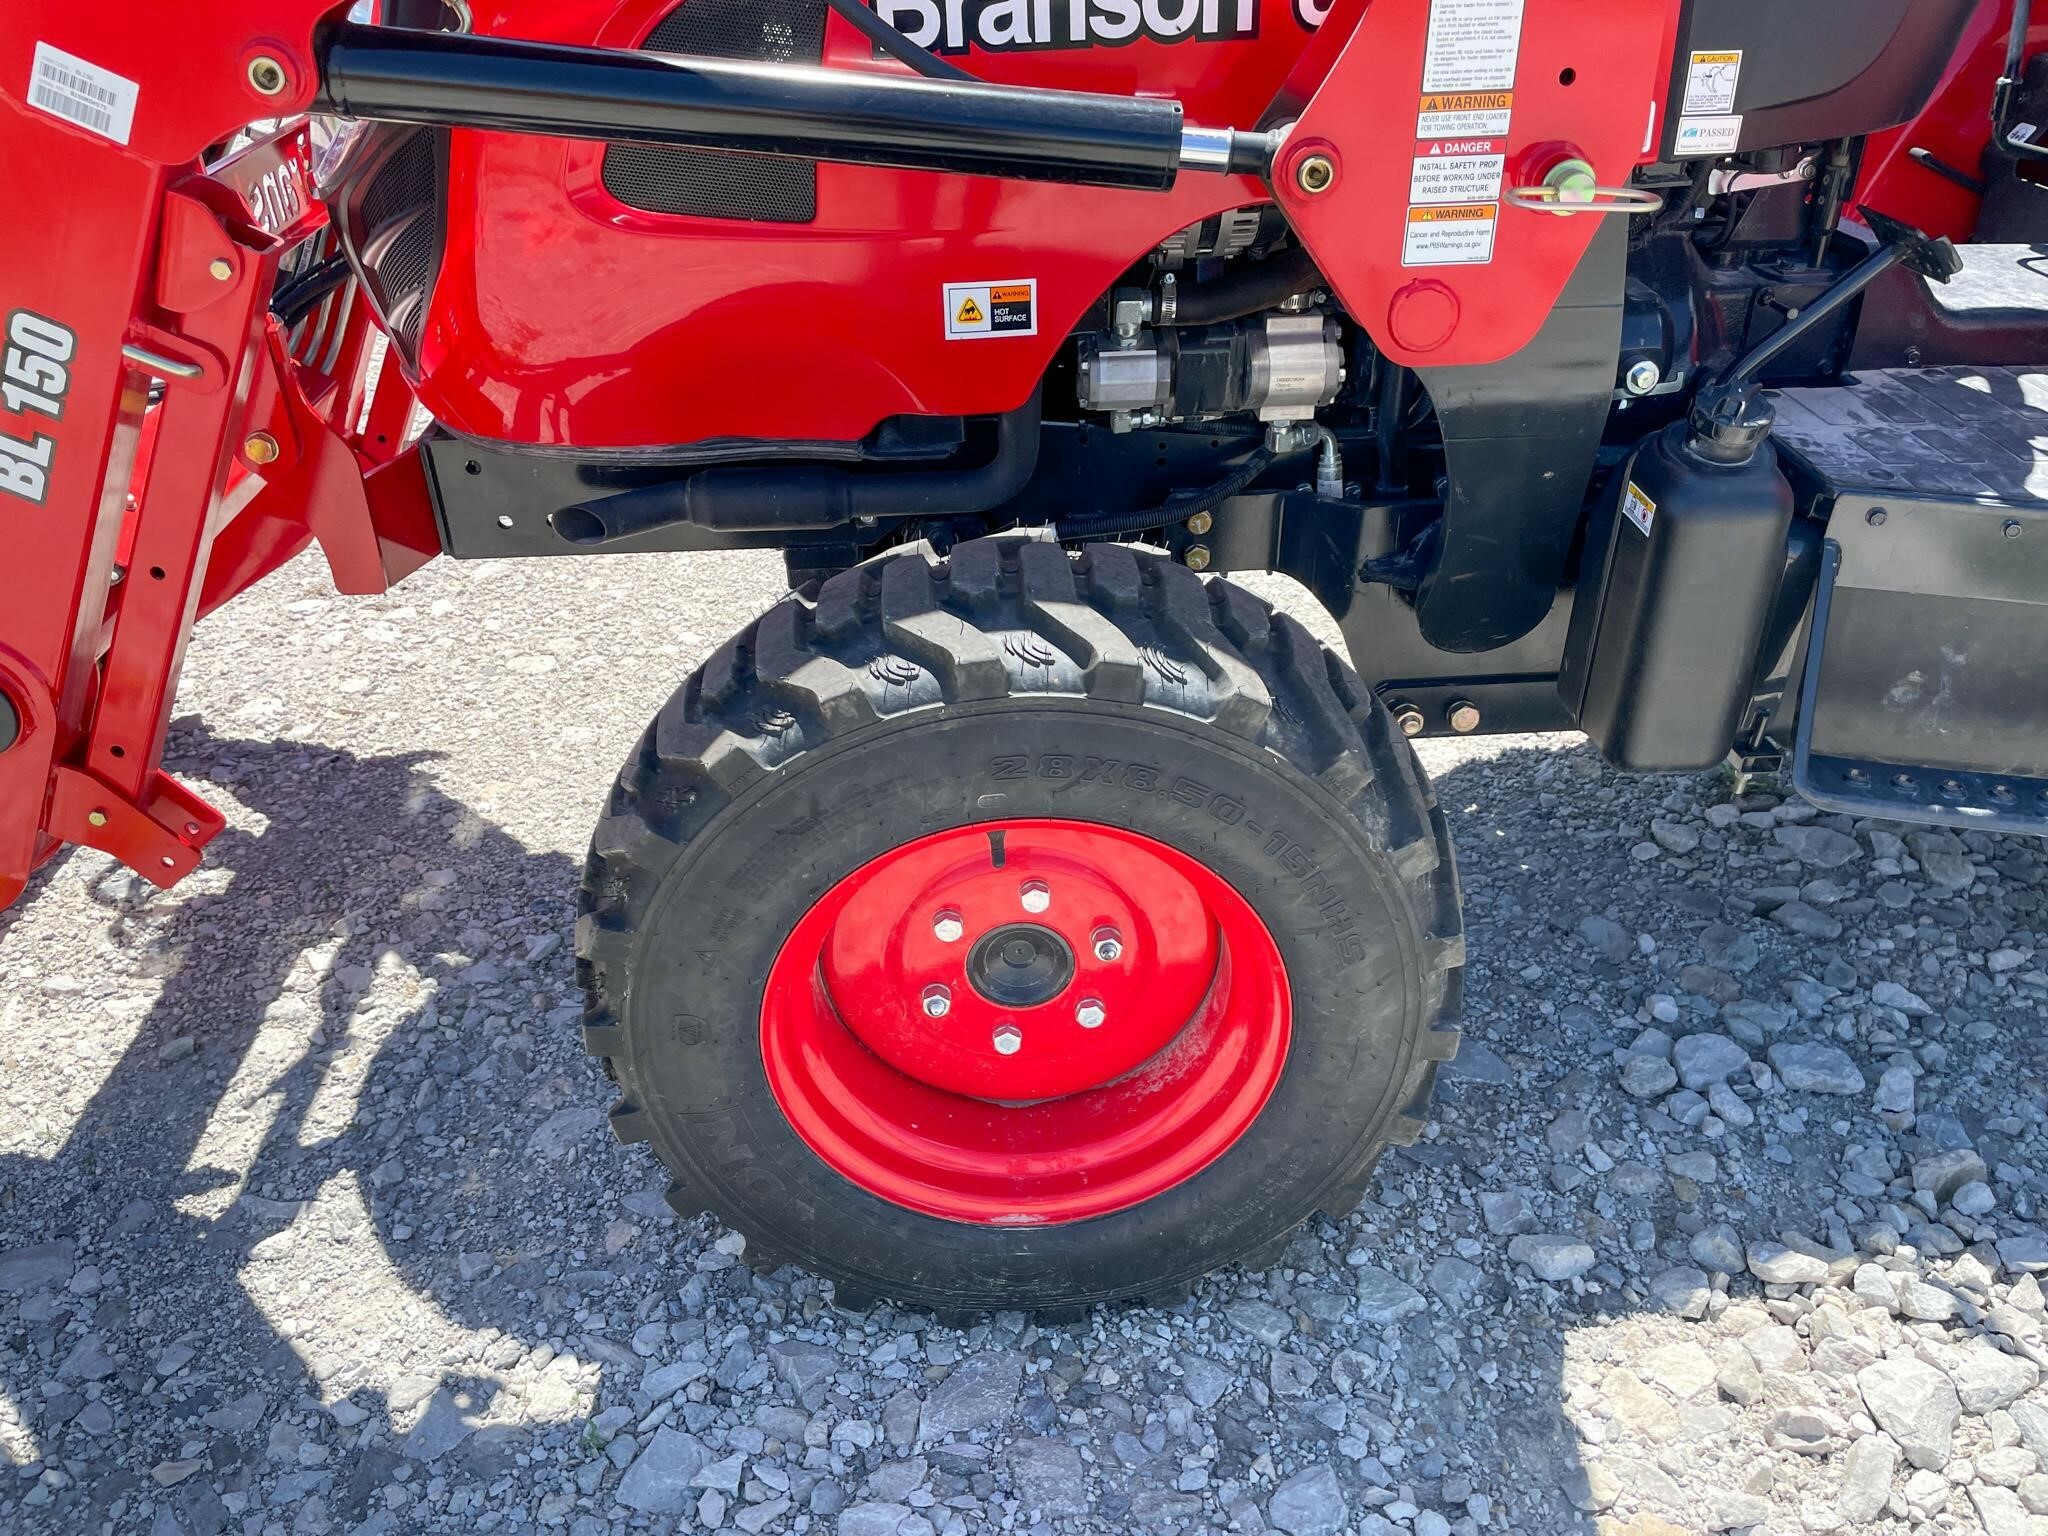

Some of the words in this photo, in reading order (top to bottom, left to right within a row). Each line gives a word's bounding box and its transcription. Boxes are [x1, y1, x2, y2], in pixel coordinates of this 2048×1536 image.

[1441, 95, 1506, 110] WARNING
[1422, 115, 1440, 123] NEVER
[1440, 114, 1452, 122] USE
[1453, 113, 1471, 121] FRONT
[1473, 112, 1485, 120] END
[1485, 112, 1508, 120] LOADER
[1420, 124, 1432, 132] FOR
[1433, 123, 1456, 131] TOWING
[1699, 128, 1735, 138] PASSED
[1444, 141, 1492, 154] DANGER
[1419, 163, 1447, 171] INSTALL
[1449, 161, 1477, 170] SAFETY
[1478, 160, 1498, 169] PROP
[1413, 174, 1441, 182] BEFORE
[1442, 173, 1475, 182] WORKING
[1477, 172, 1501, 180] UNDER
[1422, 185, 1448, 194] RAISED
[1449, 184, 1489, 193] STRUCTURE
[1435, 208, 1484, 219] WARNING
[1409, 231, 1429, 239] Cancer
[1441, 229, 1475, 238] Reproductive
[1476, 228, 1490, 236] Harm
[994, 307, 1010, 316] HOT
[994, 313, 1027, 323] SURFACE
[1, 312, 74, 415] 150
[0, 436, 52, 501] BL
